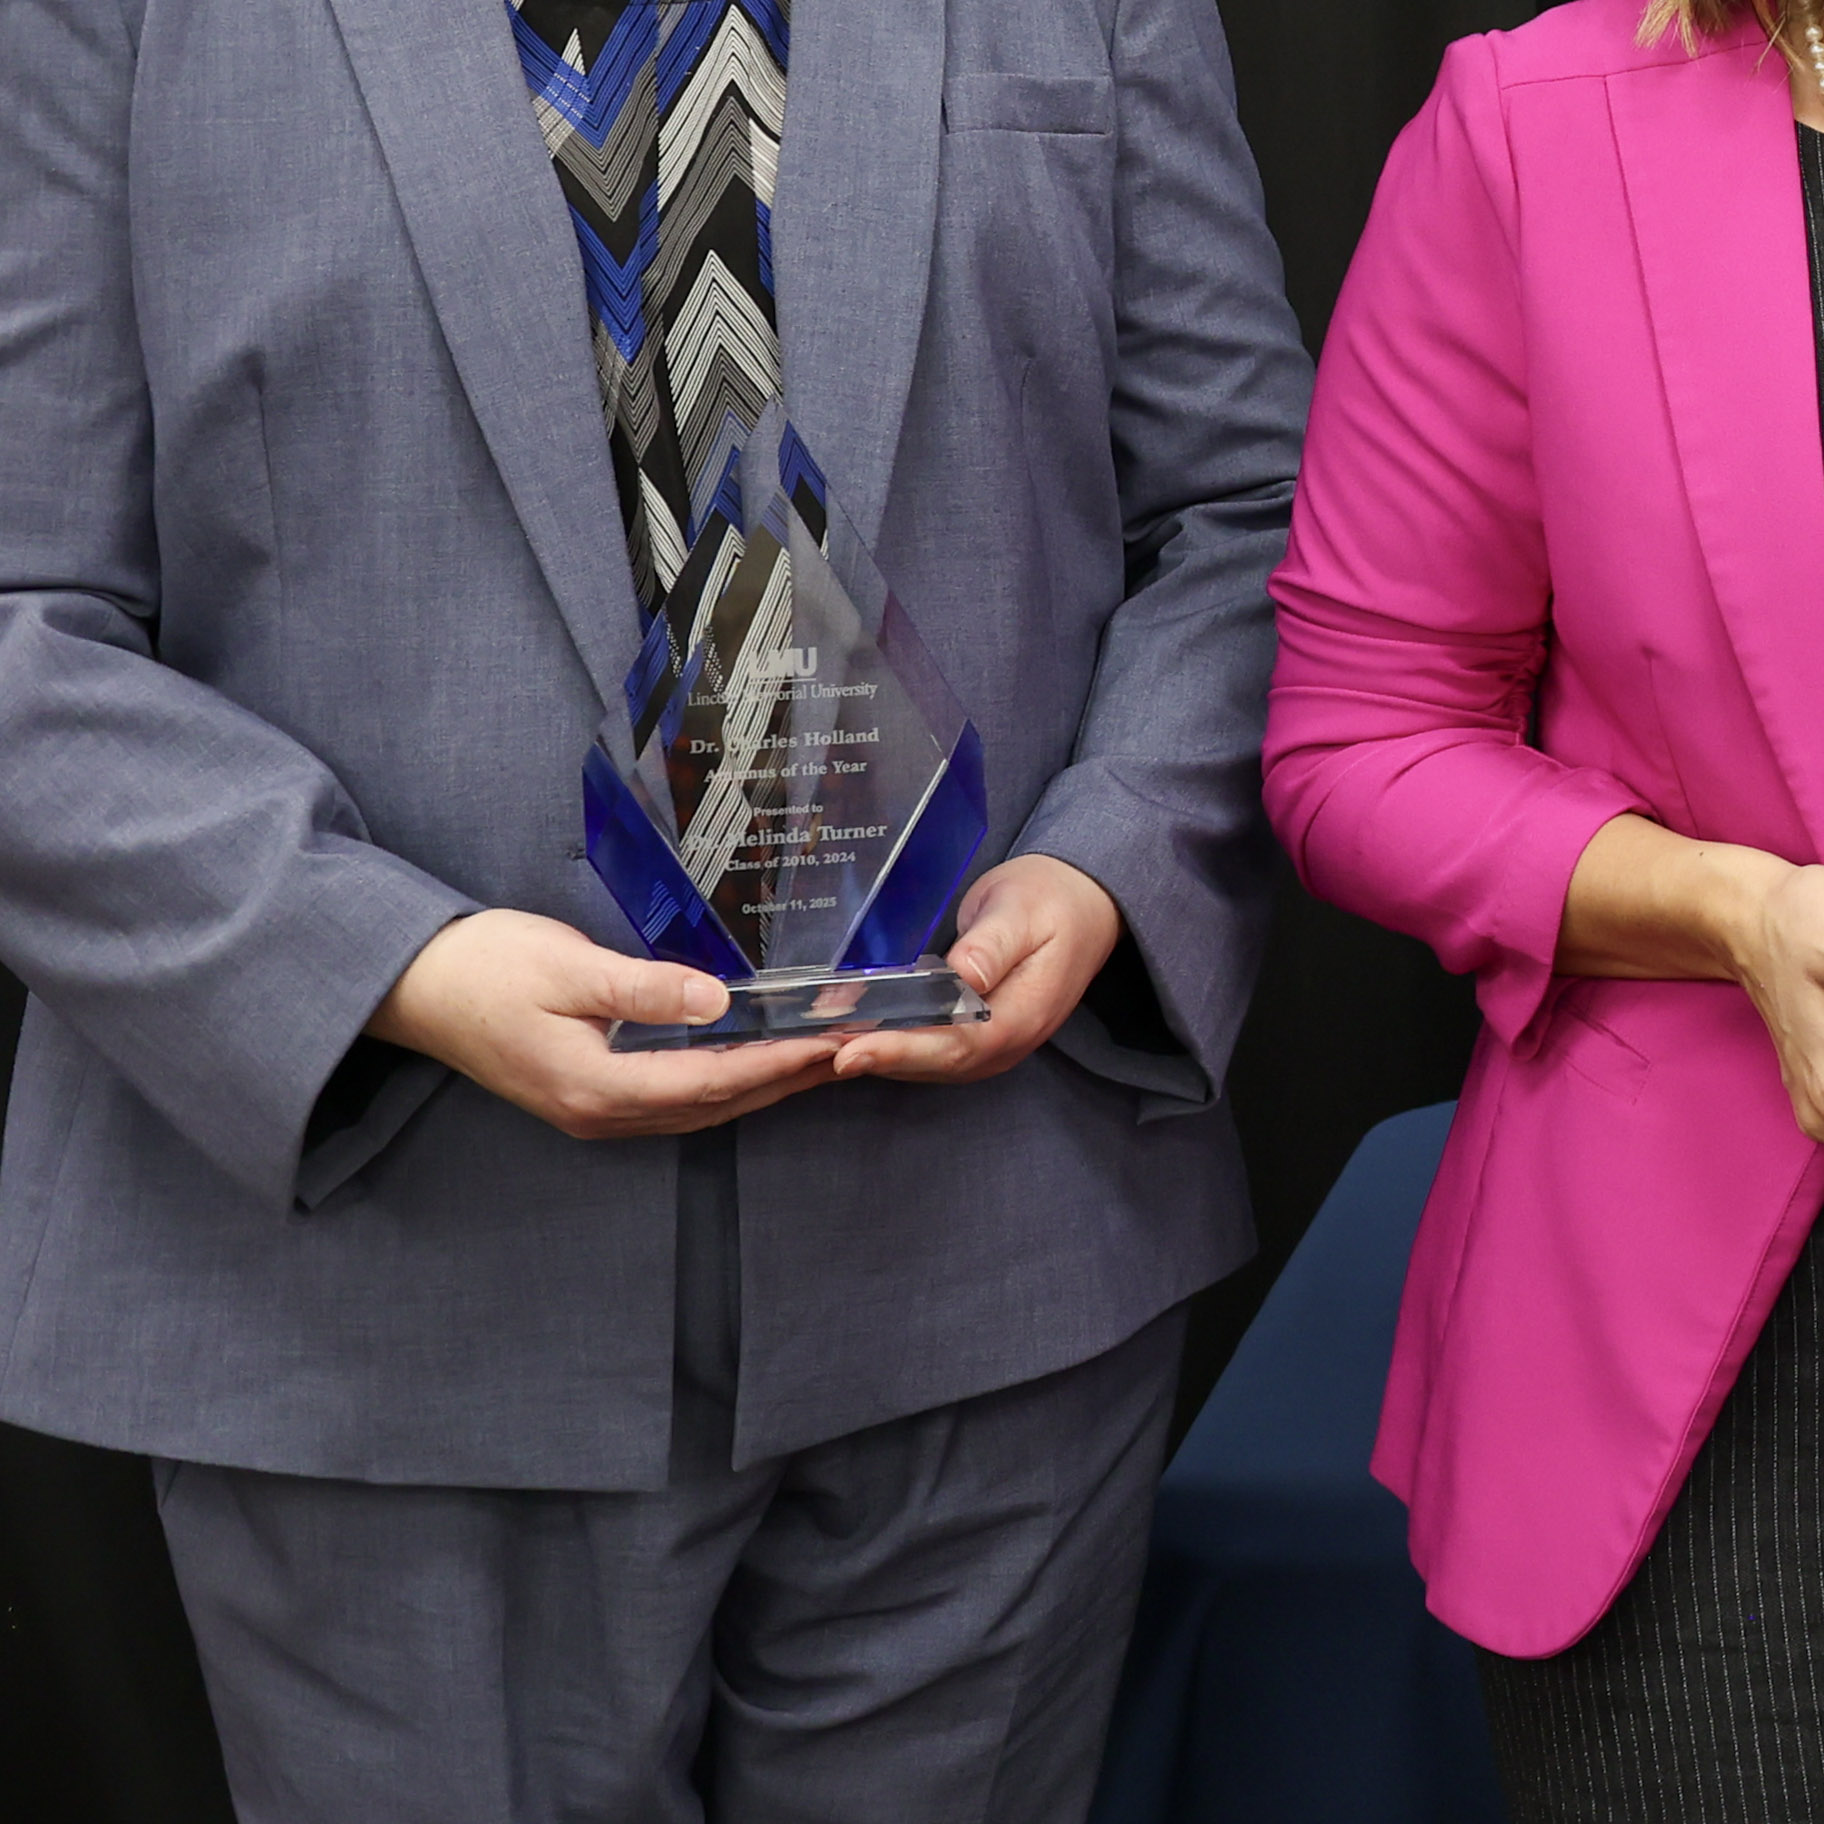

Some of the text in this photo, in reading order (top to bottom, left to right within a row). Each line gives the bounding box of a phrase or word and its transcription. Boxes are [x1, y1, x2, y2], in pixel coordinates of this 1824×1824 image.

[749, 647, 817, 678] LMU
[687, 682, 878, 707] Linco Morial University
[689, 728, 880, 755] Dr. Charles Holland
[780, 763, 799, 777] of
[802, 762, 828, 776] the
[832, 760, 868, 774] Year
[753, 804, 824, 817] Presented to
[725, 827, 811, 848] Melinda
[817, 825, 888, 842] Turner
[725, 851, 856, 872] Class of 2010, 2024
[741, 897, 838, 915] October 11, 2025
